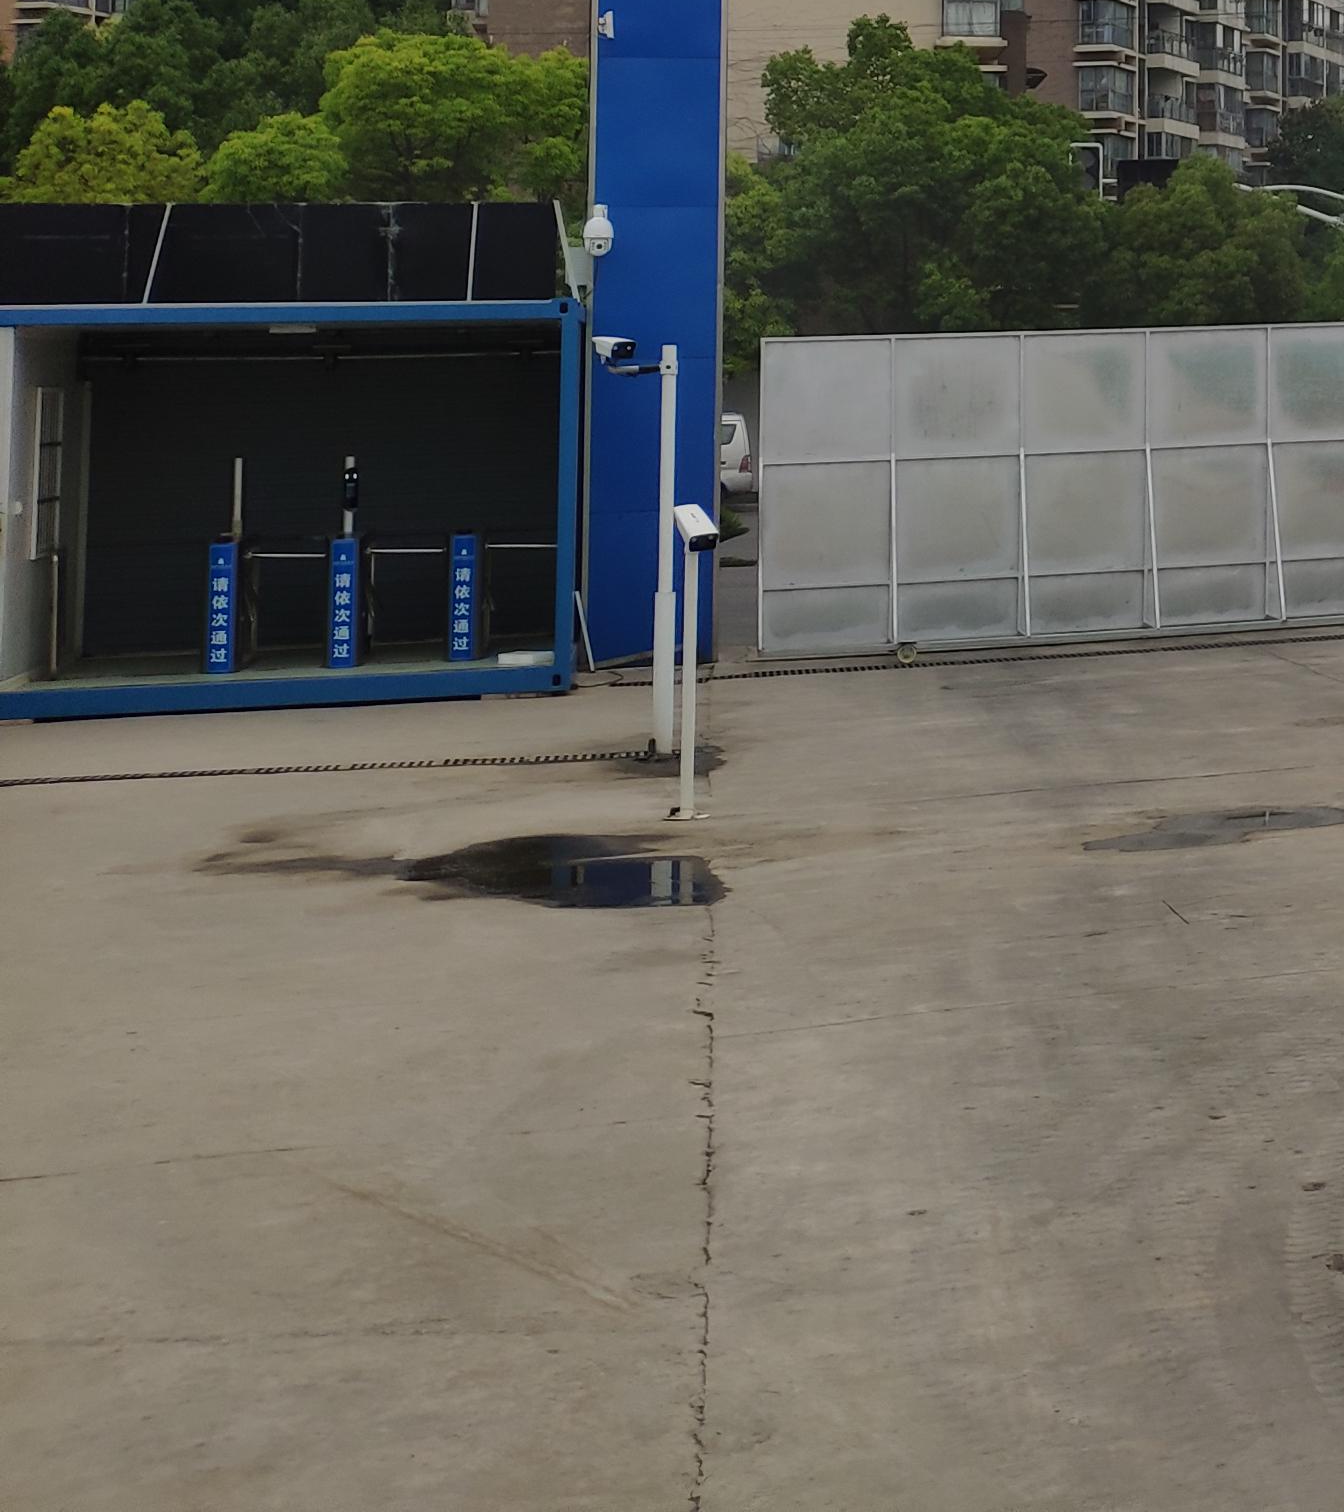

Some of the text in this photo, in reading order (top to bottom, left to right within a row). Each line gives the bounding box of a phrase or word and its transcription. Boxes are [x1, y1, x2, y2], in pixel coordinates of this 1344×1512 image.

[210, 577, 228, 663] 请依次通过
[333, 573, 351, 658] 请依次通过
[453, 567, 470, 651] 请依次通过
